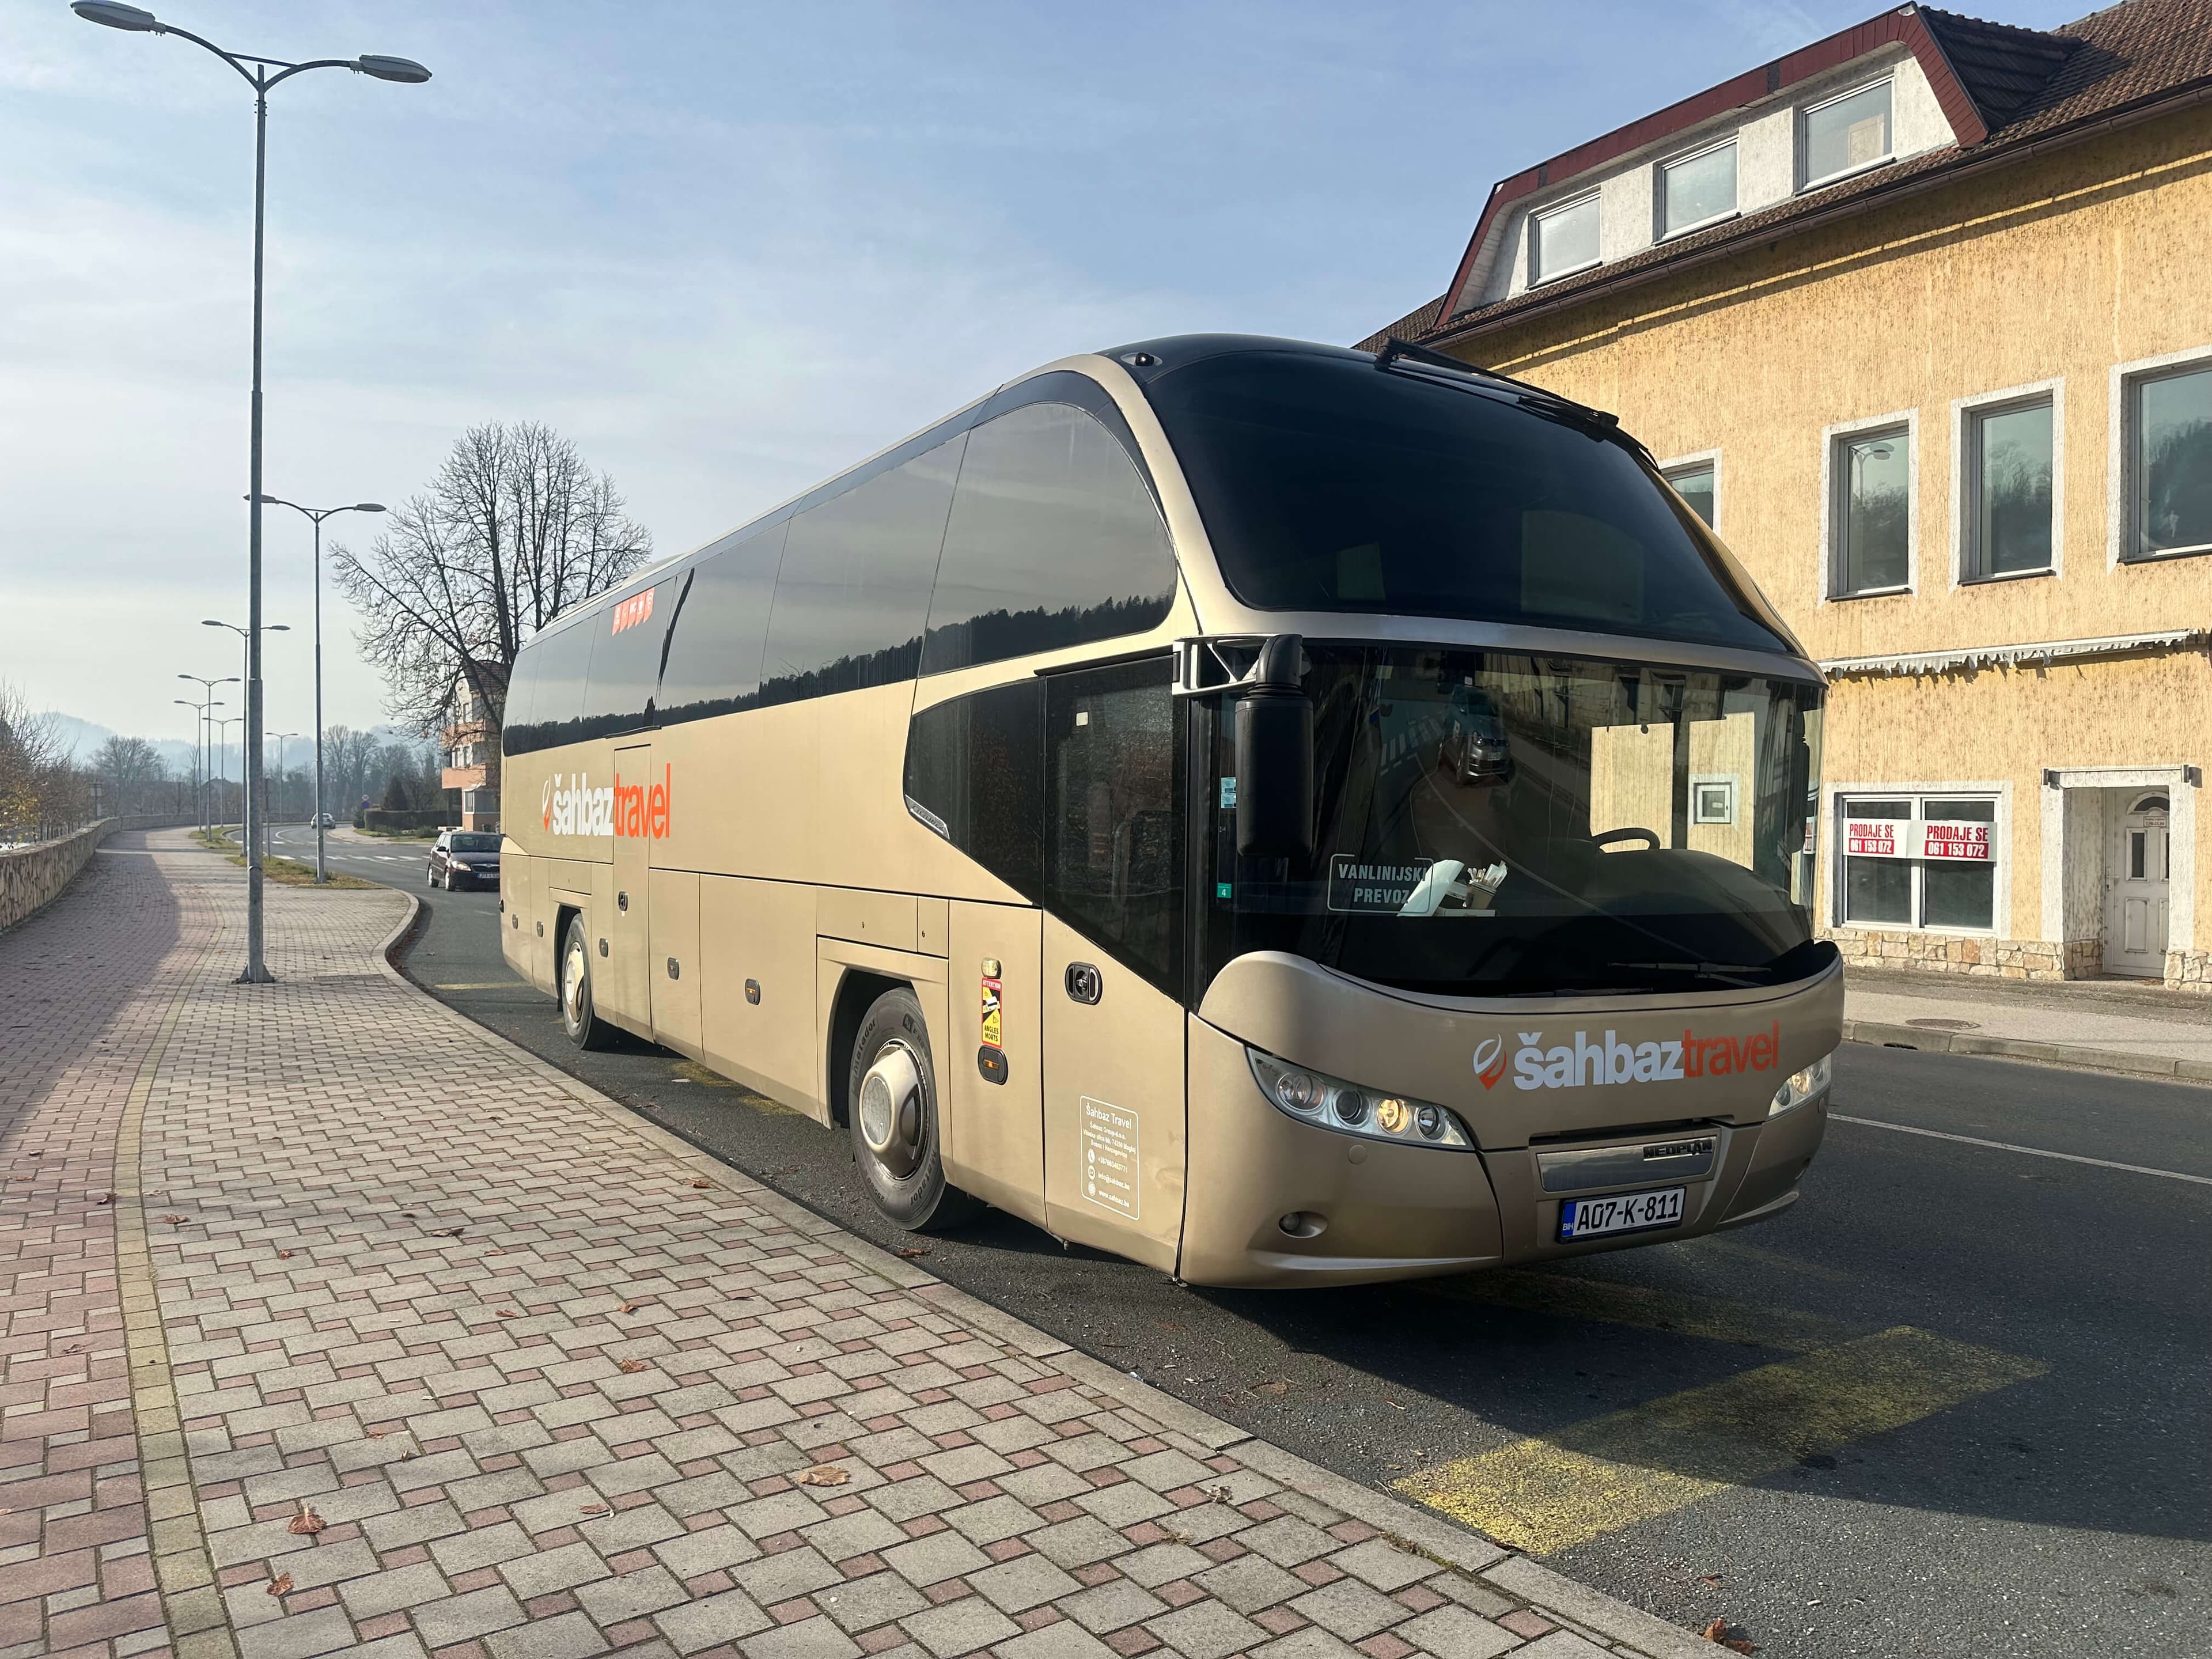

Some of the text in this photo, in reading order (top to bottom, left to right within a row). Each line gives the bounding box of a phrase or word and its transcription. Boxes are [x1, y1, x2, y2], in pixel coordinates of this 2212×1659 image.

[1849, 823, 1894, 838] PRODAJE SE
[1926, 825, 1988, 842] PRODAJE SE
[1850, 839, 1892, 853] 061 153 072
[1927, 842, 1985, 857] 061 153 072
[1338, 863, 1427, 881] VANLINIJSKI
[1221, 888, 1226, 897] 4
[1354, 888, 1410, 904] PREVOZ
[984, 1025, 999, 1035] ANGLES
[985, 1032, 998, 1042] MORTS
[1086, 1102, 1132, 1130] Šahbaz Travel
[1562, 1192, 1679, 1231] BIH A07-K-811
